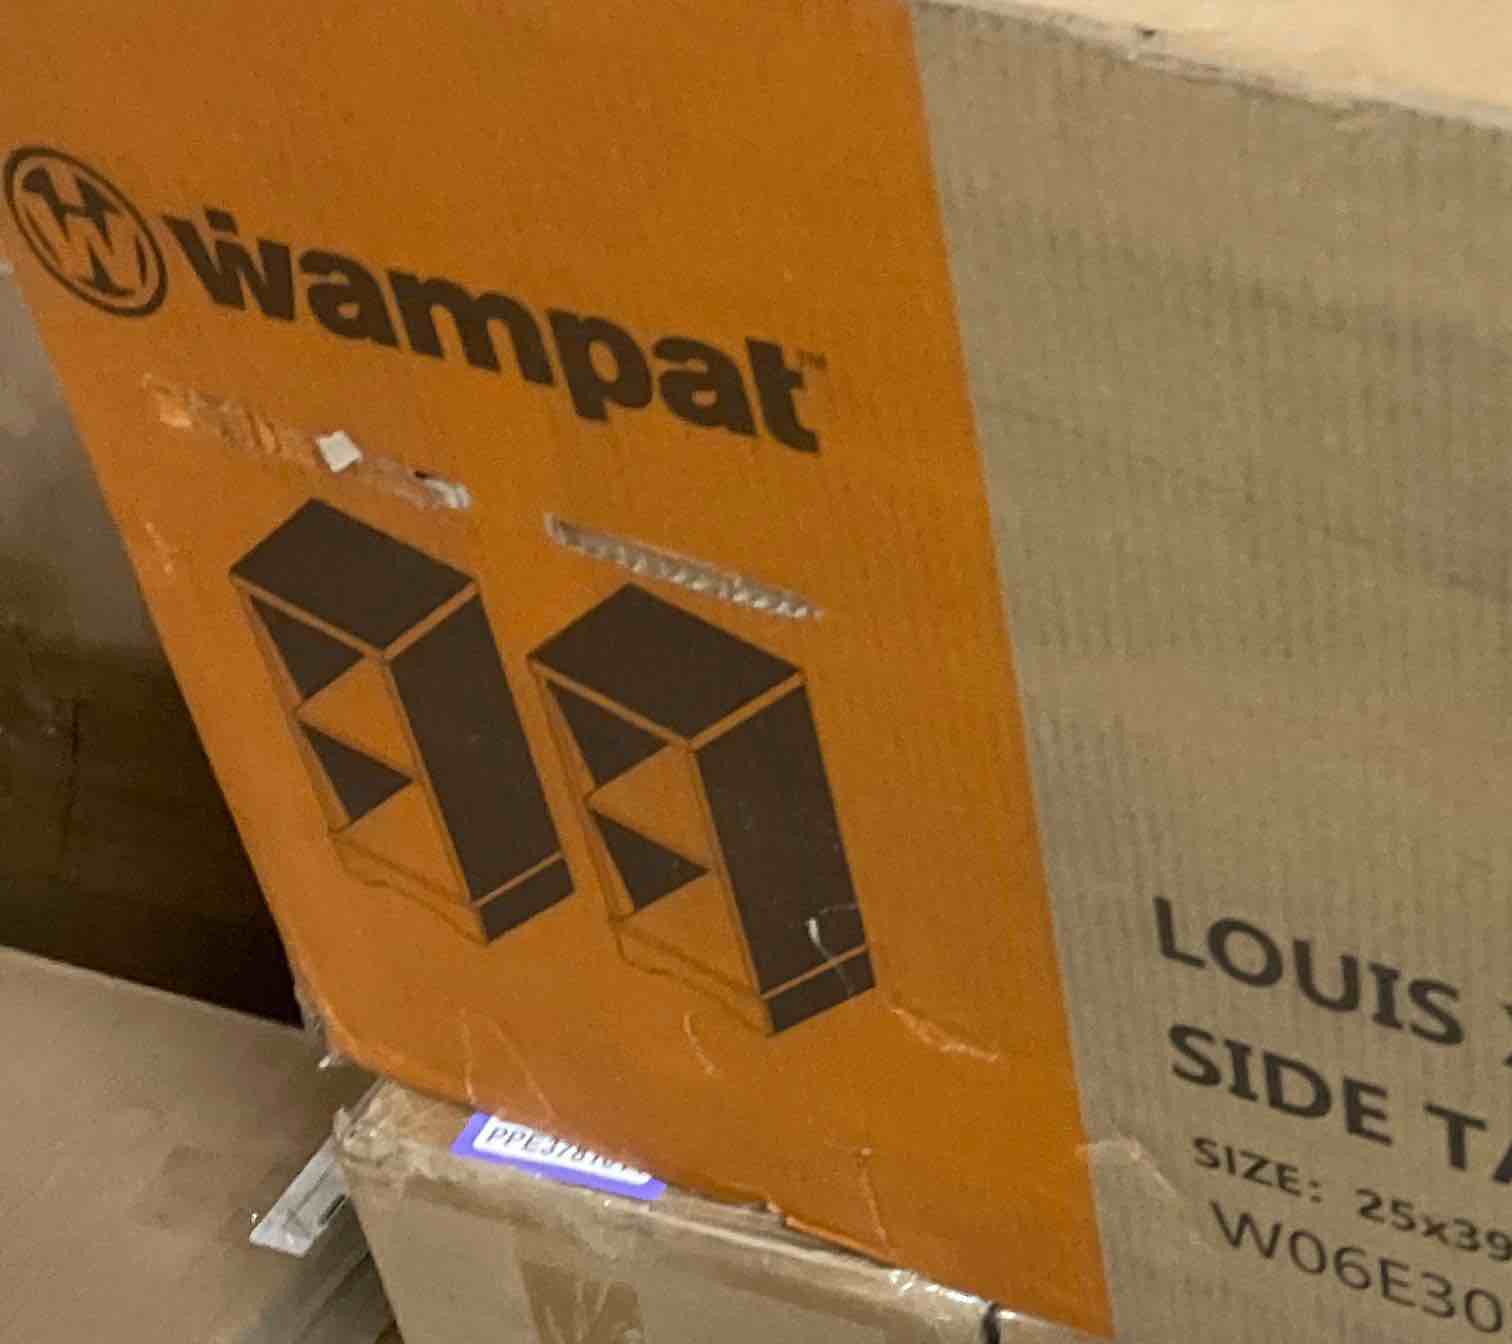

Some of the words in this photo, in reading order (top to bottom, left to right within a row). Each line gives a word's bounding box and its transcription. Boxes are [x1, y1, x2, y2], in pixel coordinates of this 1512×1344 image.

[1152, 896, 1465, 1047] LOUIS
[1167, 1023, 1393, 1147] SIDE
[1192, 1135, 1324, 1204] SIZE:
